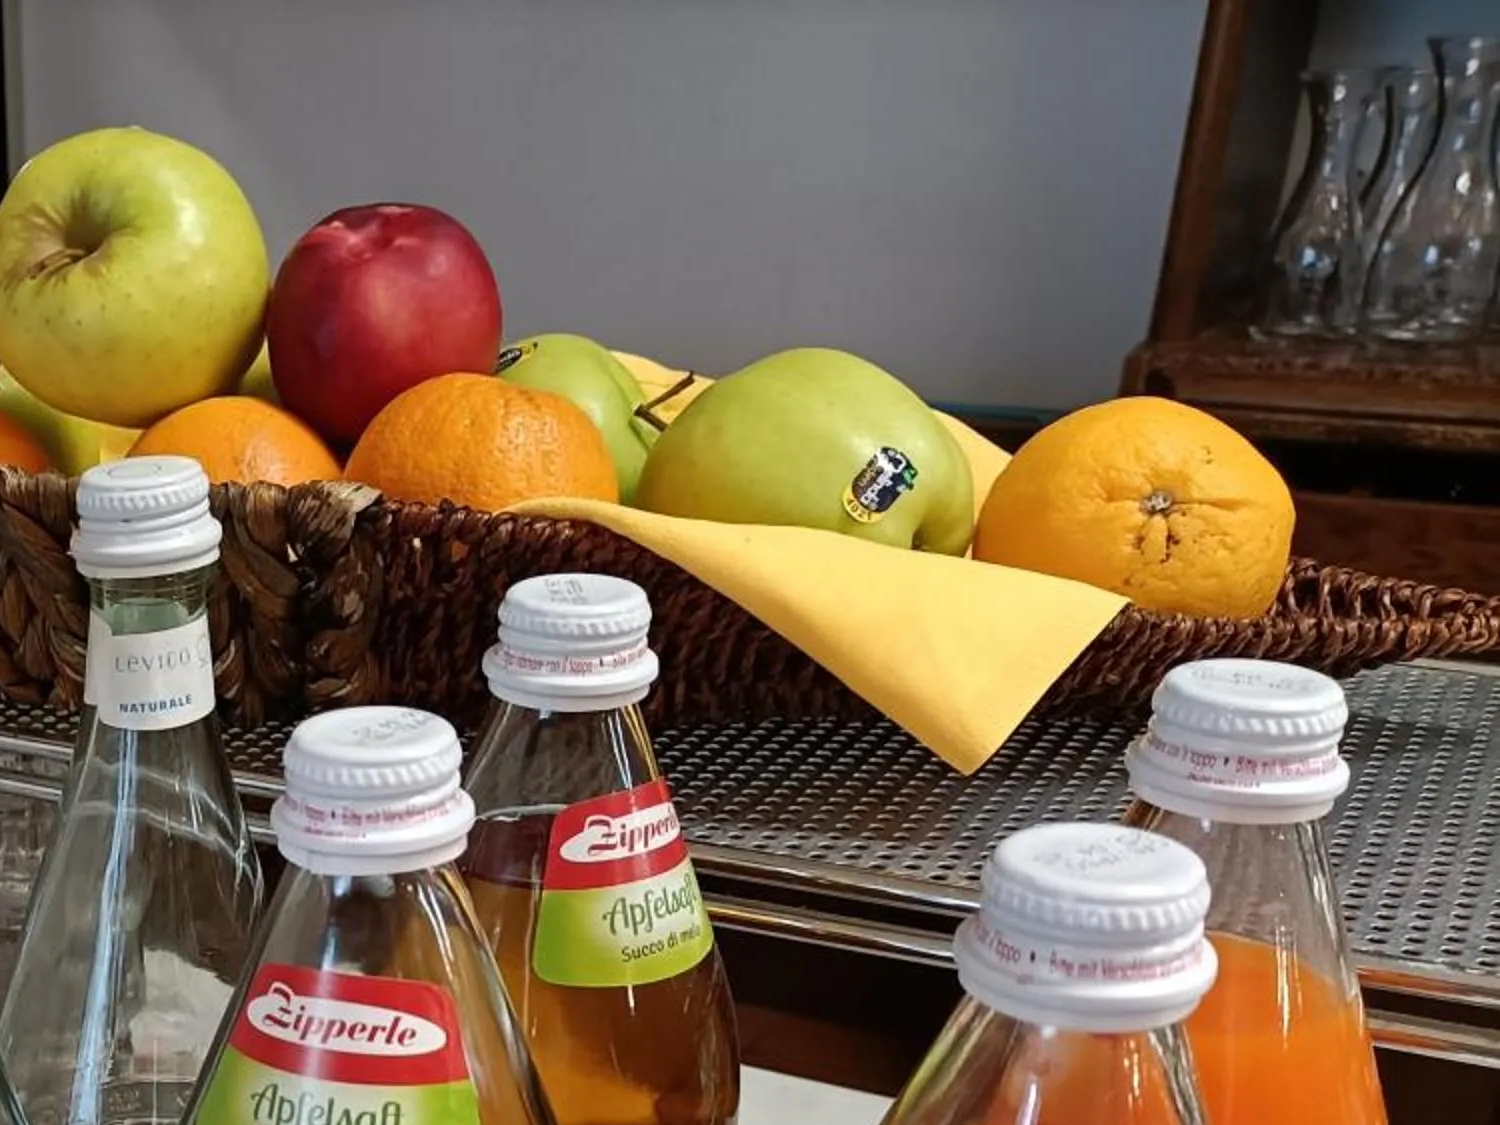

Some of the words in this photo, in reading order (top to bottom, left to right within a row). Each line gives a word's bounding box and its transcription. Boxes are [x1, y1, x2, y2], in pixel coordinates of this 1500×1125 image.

[118, 693, 193, 713] NATURALE
[621, 940, 665, 962] Succo
[667, 932, 679, 948] di
[262, 985, 417, 1047] Zipperle
